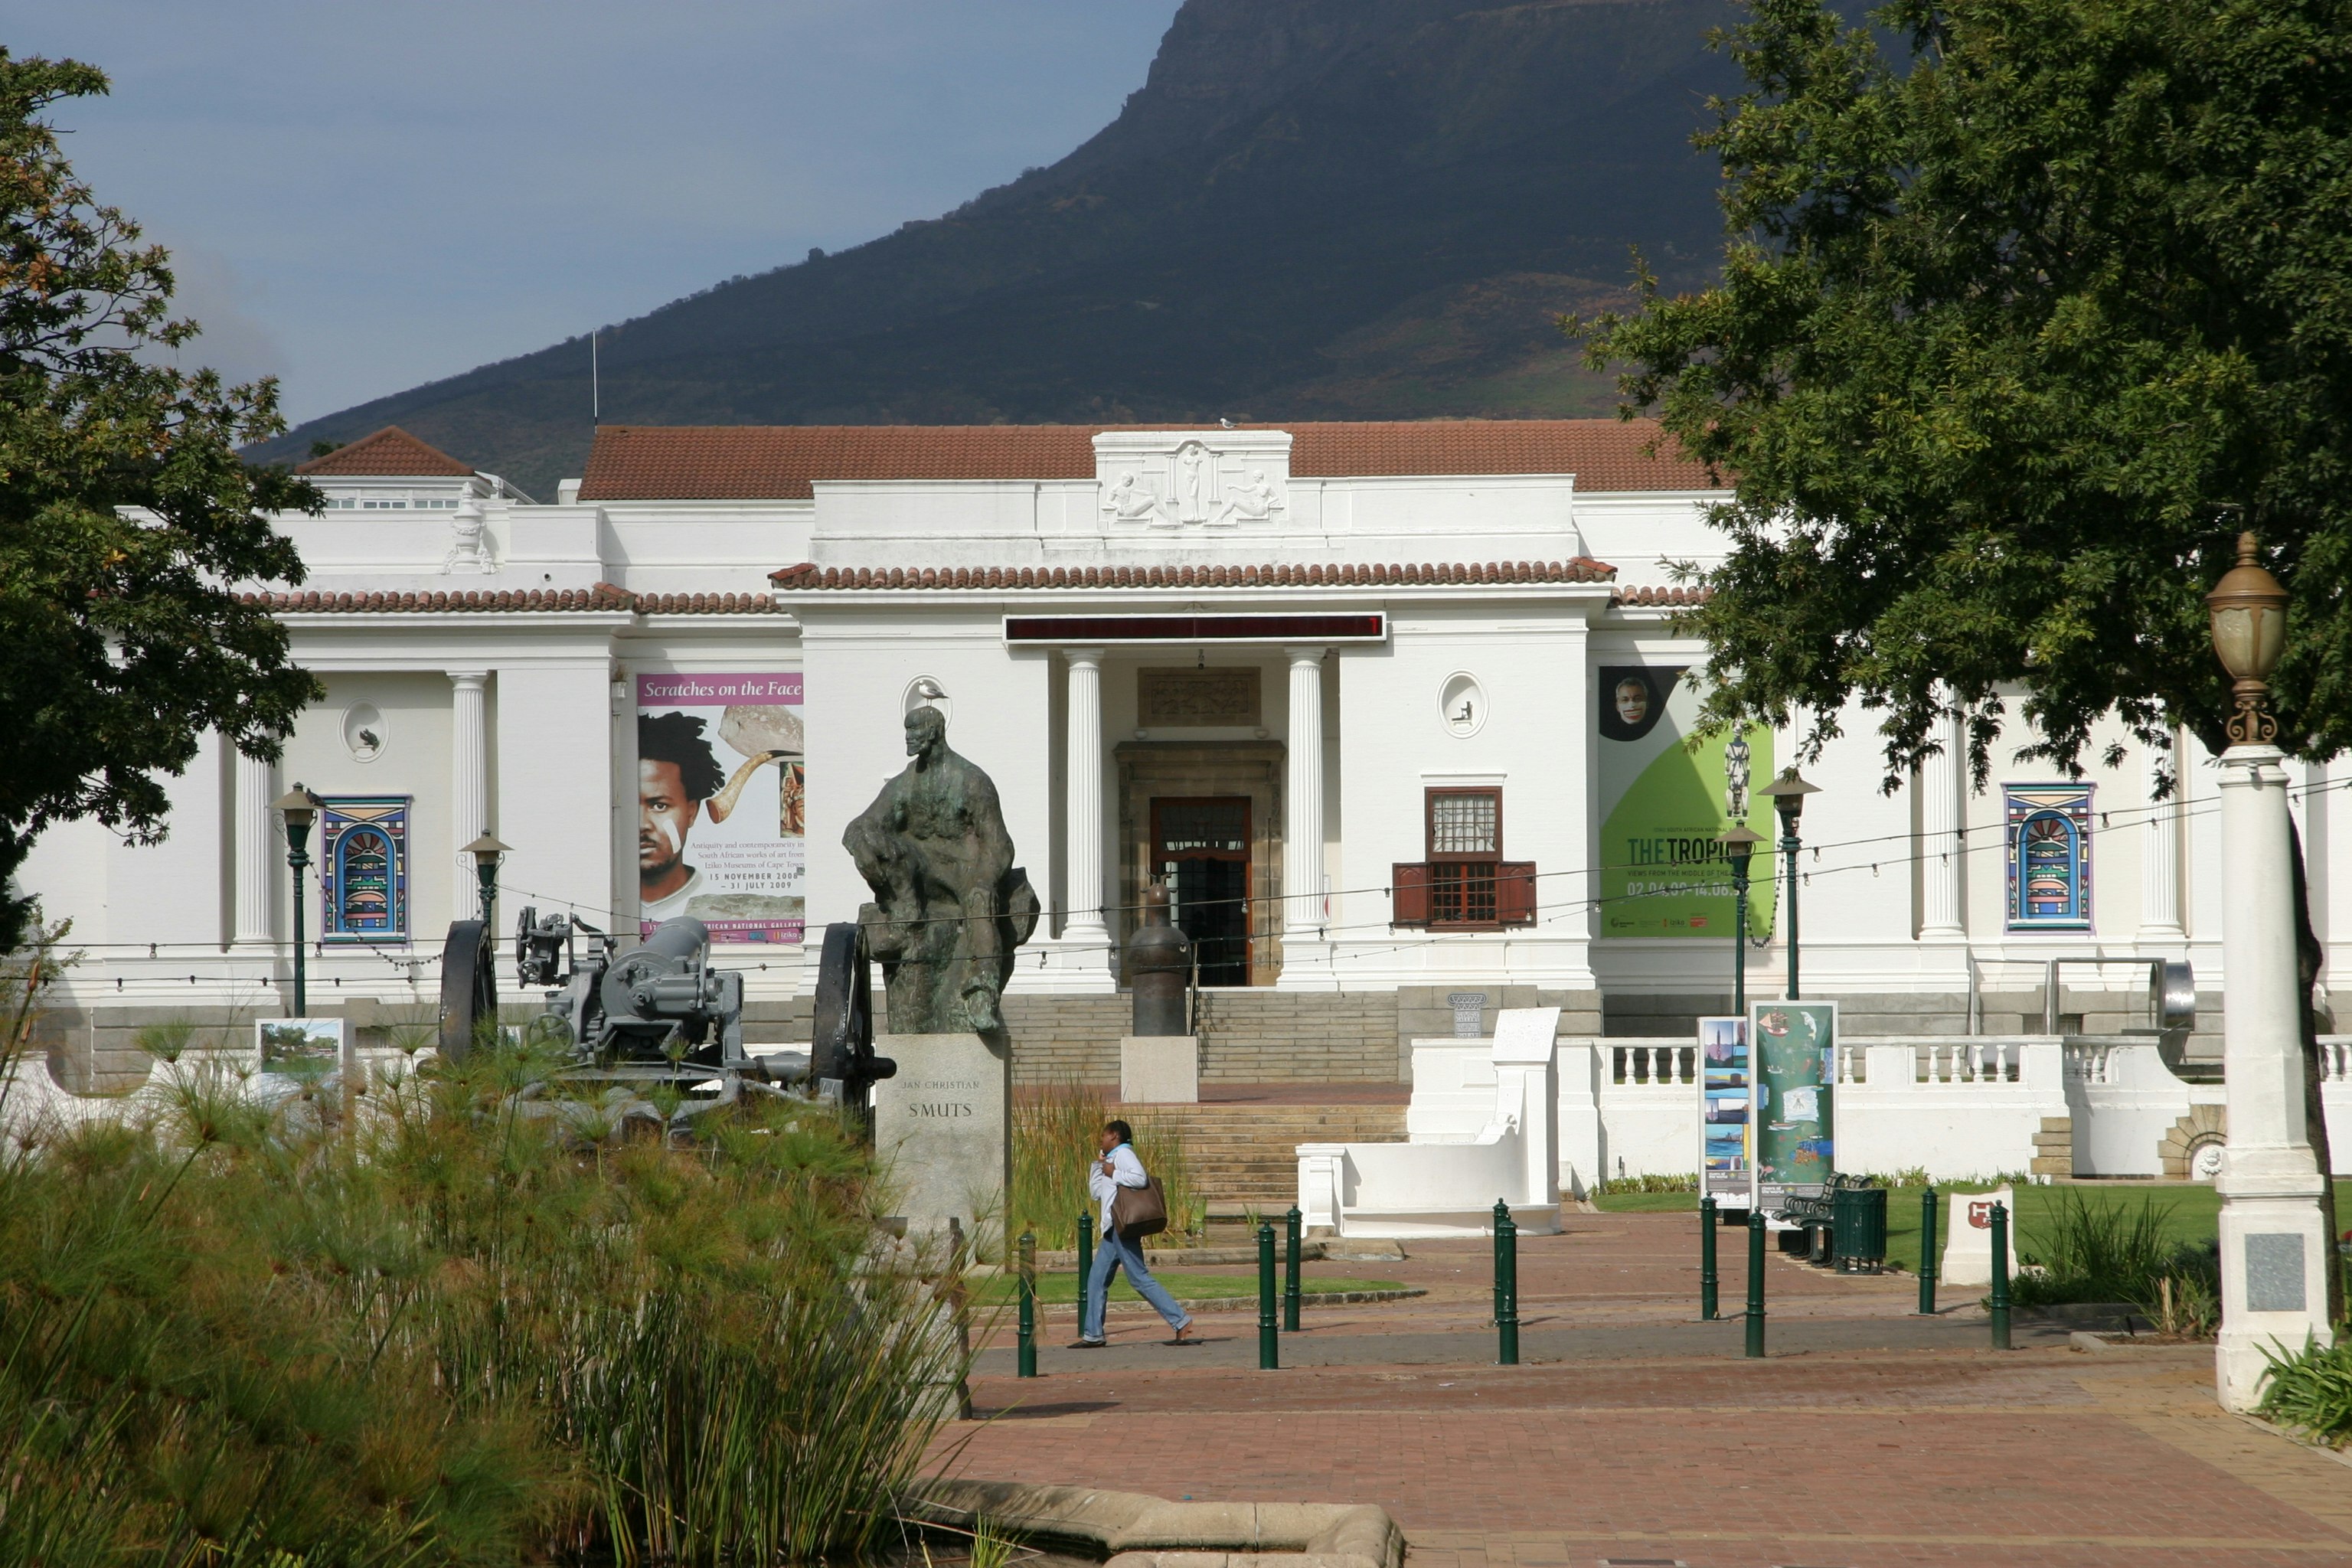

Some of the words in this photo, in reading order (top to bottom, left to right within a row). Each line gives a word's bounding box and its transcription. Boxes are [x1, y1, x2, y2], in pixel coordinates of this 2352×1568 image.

[645, 681, 714, 697] Scratches
[718, 684, 736, 696] on
[741, 681, 763, 696] the
[767, 681, 802, 696] Face
[1628, 838, 1664, 864] THE
[1667, 838, 1733, 864] TROPI
[766, 861, 784, 870] Cape
[746, 882, 765, 890] JULY
[1627, 882, 1740, 897] 02.04.09-14.06.
[909, 1103, 972, 1117] SMUTS
